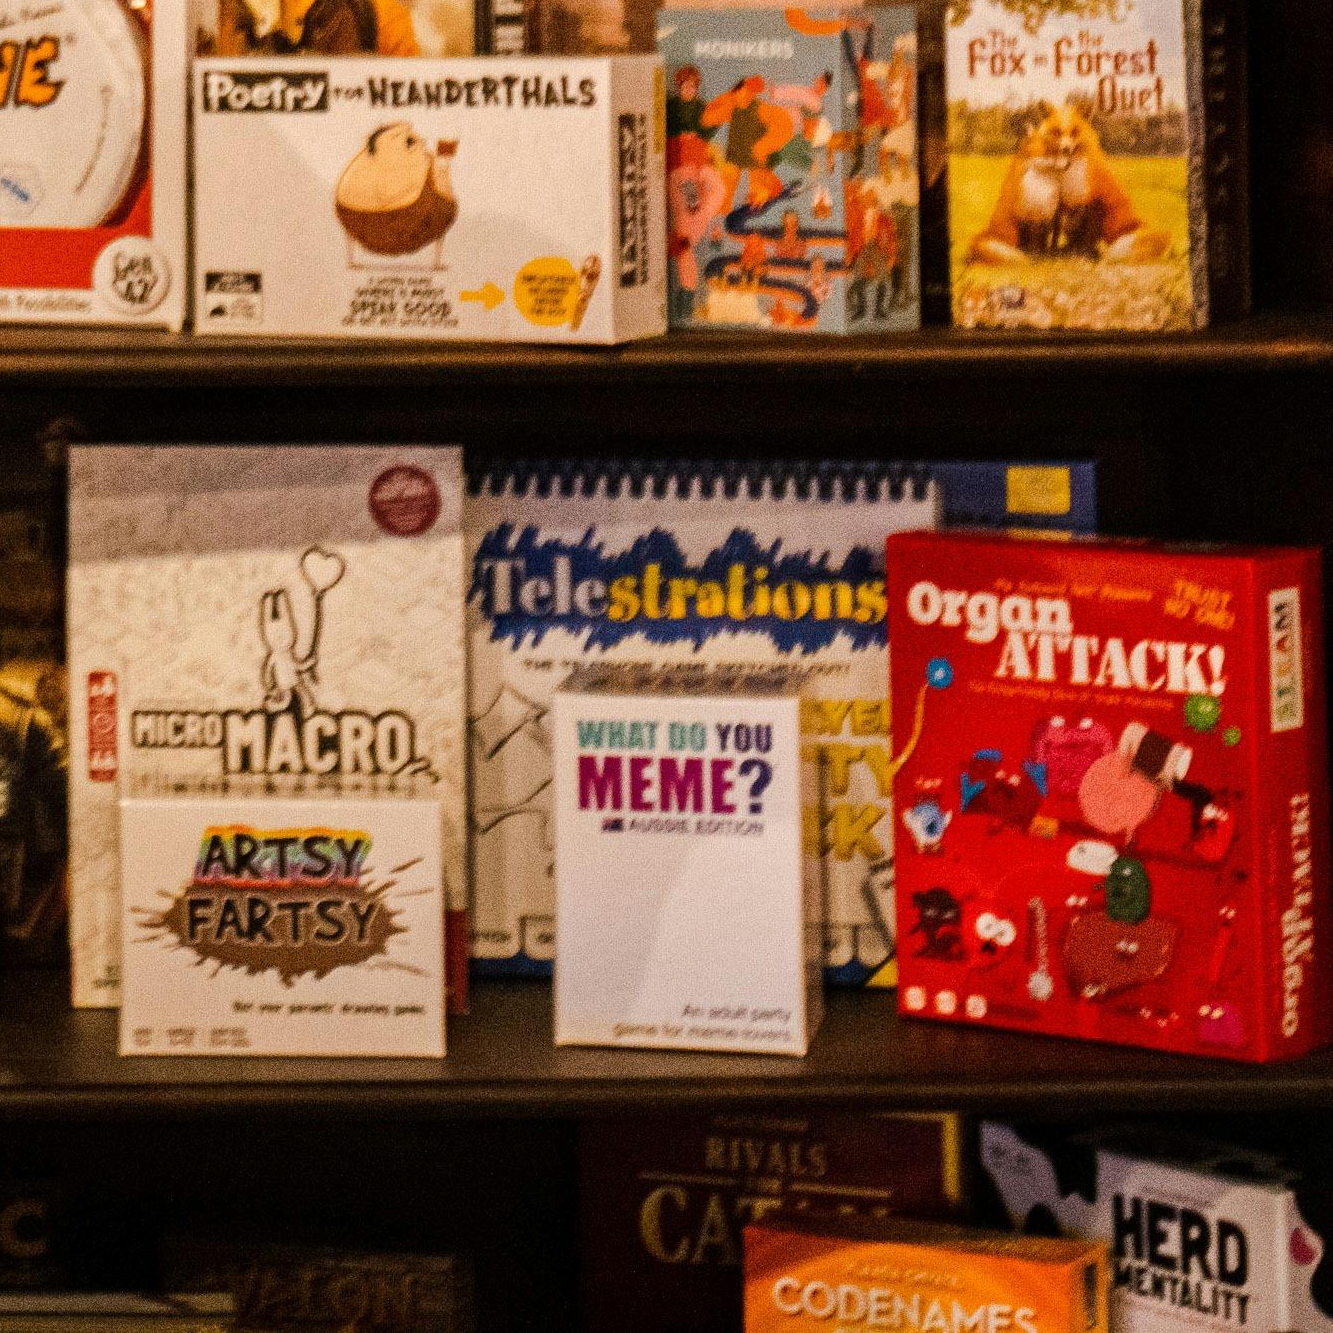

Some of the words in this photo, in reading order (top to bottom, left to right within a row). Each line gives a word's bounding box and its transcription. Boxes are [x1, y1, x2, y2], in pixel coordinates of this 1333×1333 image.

[694, 39, 795, 62] MONIKERS
[968, 36, 1026, 78] Fox
[1053, 36, 1158, 78] Forest
[210, 74, 326, 112] Poetry
[369, 76, 597, 109] NEANDERTHALS
[1096, 74, 1164, 114] Duet
[481, 560, 889, 625] Telestrations
[906, 580, 1075, 645] Organ
[993, 630, 1227, 697] ATTACK!
[133, 713, 223, 748] MICRO
[225, 712, 417, 776] MACRO
[576, 720, 659, 750] WHAT
[668, 722, 707, 750] DO
[715, 722, 773, 754] YOU
[577, 755, 774, 815] MEME?
[201, 833, 366, 880] ARTSY
[188, 897, 376, 943] FARTSY
[1113, 1192, 1249, 1287] HERD
[771, 1276, 1038, 1333] CODENAMES
[1113, 1266, 1250, 1328] MENTALITY
